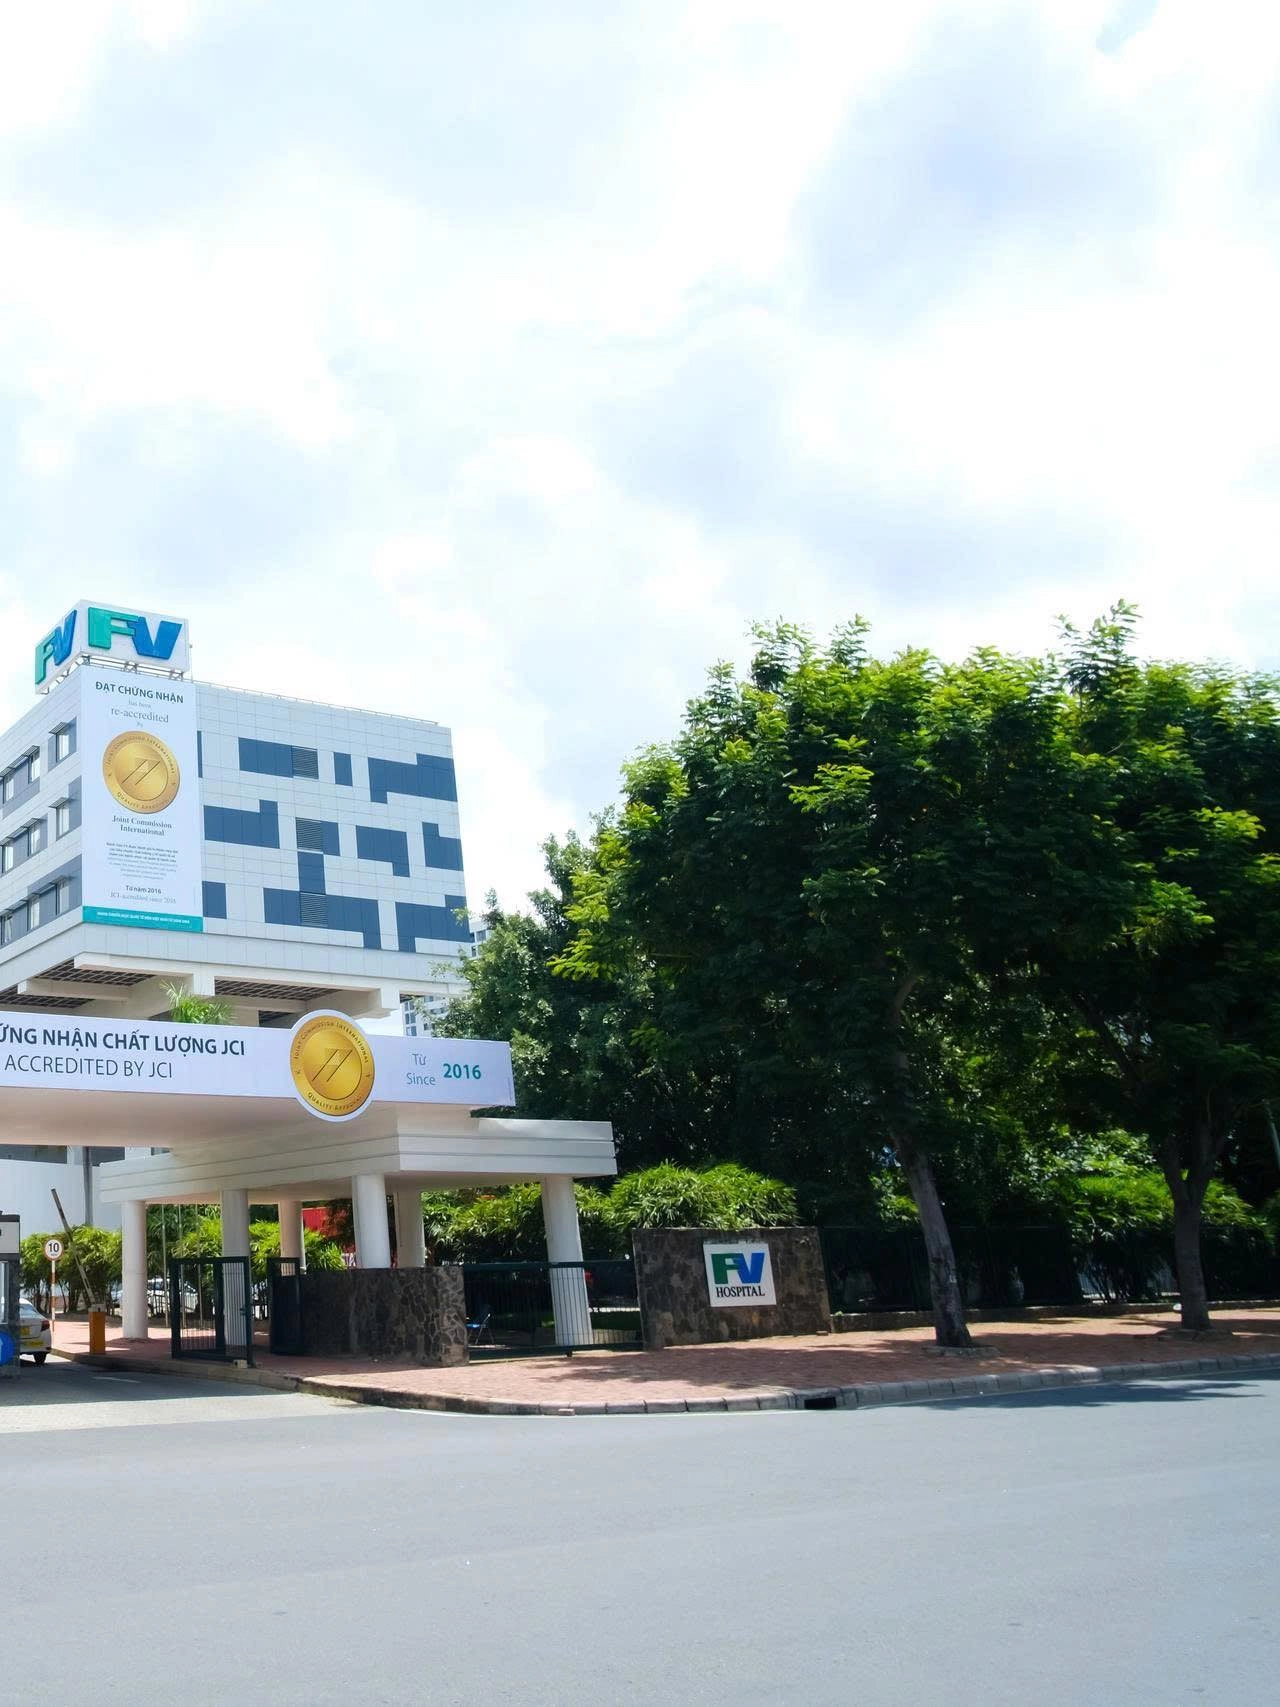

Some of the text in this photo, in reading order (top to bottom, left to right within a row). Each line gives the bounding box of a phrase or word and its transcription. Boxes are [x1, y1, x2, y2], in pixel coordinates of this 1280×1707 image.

[88, 607, 182, 660] FV
[35, 610, 77, 684] FV
[95, 681, 184, 705] ĐẠT CHỨNG NHẬN
[111, 707, 169, 723] re-accredited
[112, 815, 172, 829] Joint Commission
[120, 824, 165, 837] International
[43, 1028, 98, 1052] NHẬN
[103, 1029, 149, 1051] CHẤT
[155, 1036, 217, 1058] LƯỢNG
[221, 1039, 245, 1056] JCI
[4, 1054, 118, 1076] ACCREDITED
[124, 1061, 144, 1077] BY
[148, 1061, 172, 1079] JCI
[412, 1053, 427, 1066] Từ
[406, 1072, 436, 1086] Since
[443, 1063, 481, 1080] 2016
[48, 1242, 59, 1253] 10
[711, 1253, 765, 1284] FV
[715, 1286, 765, 1298] HOSPITAL
